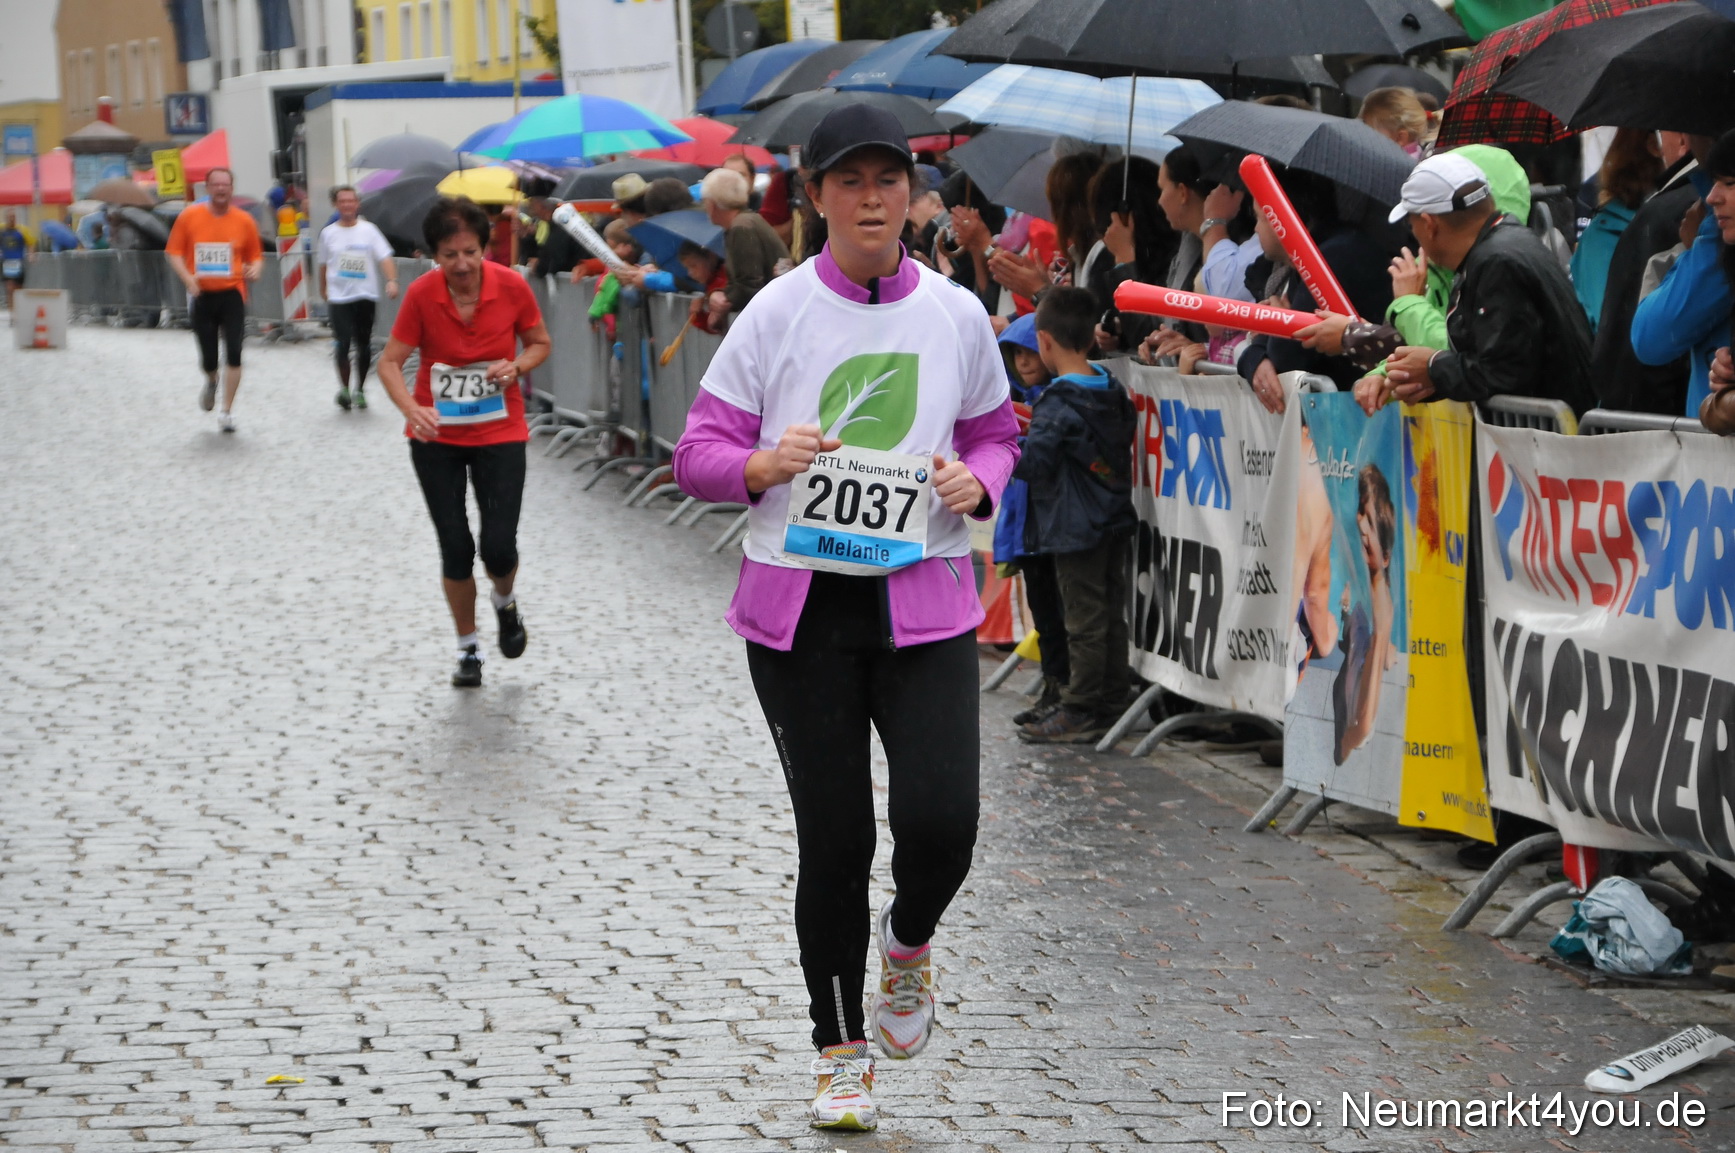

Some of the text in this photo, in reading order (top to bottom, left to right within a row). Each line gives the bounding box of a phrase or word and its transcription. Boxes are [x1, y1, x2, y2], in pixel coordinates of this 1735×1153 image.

[198, 250, 228, 263] 3415
[1290, 249, 1312, 282] BKK
[1216, 301, 1295, 325] Audi BKK
[848, 459, 910, 480] Neumarkt
[802, 473, 919, 533] 2037
[817, 535, 890, 562] Melanie
[1410, 637, 1448, 657] atten
